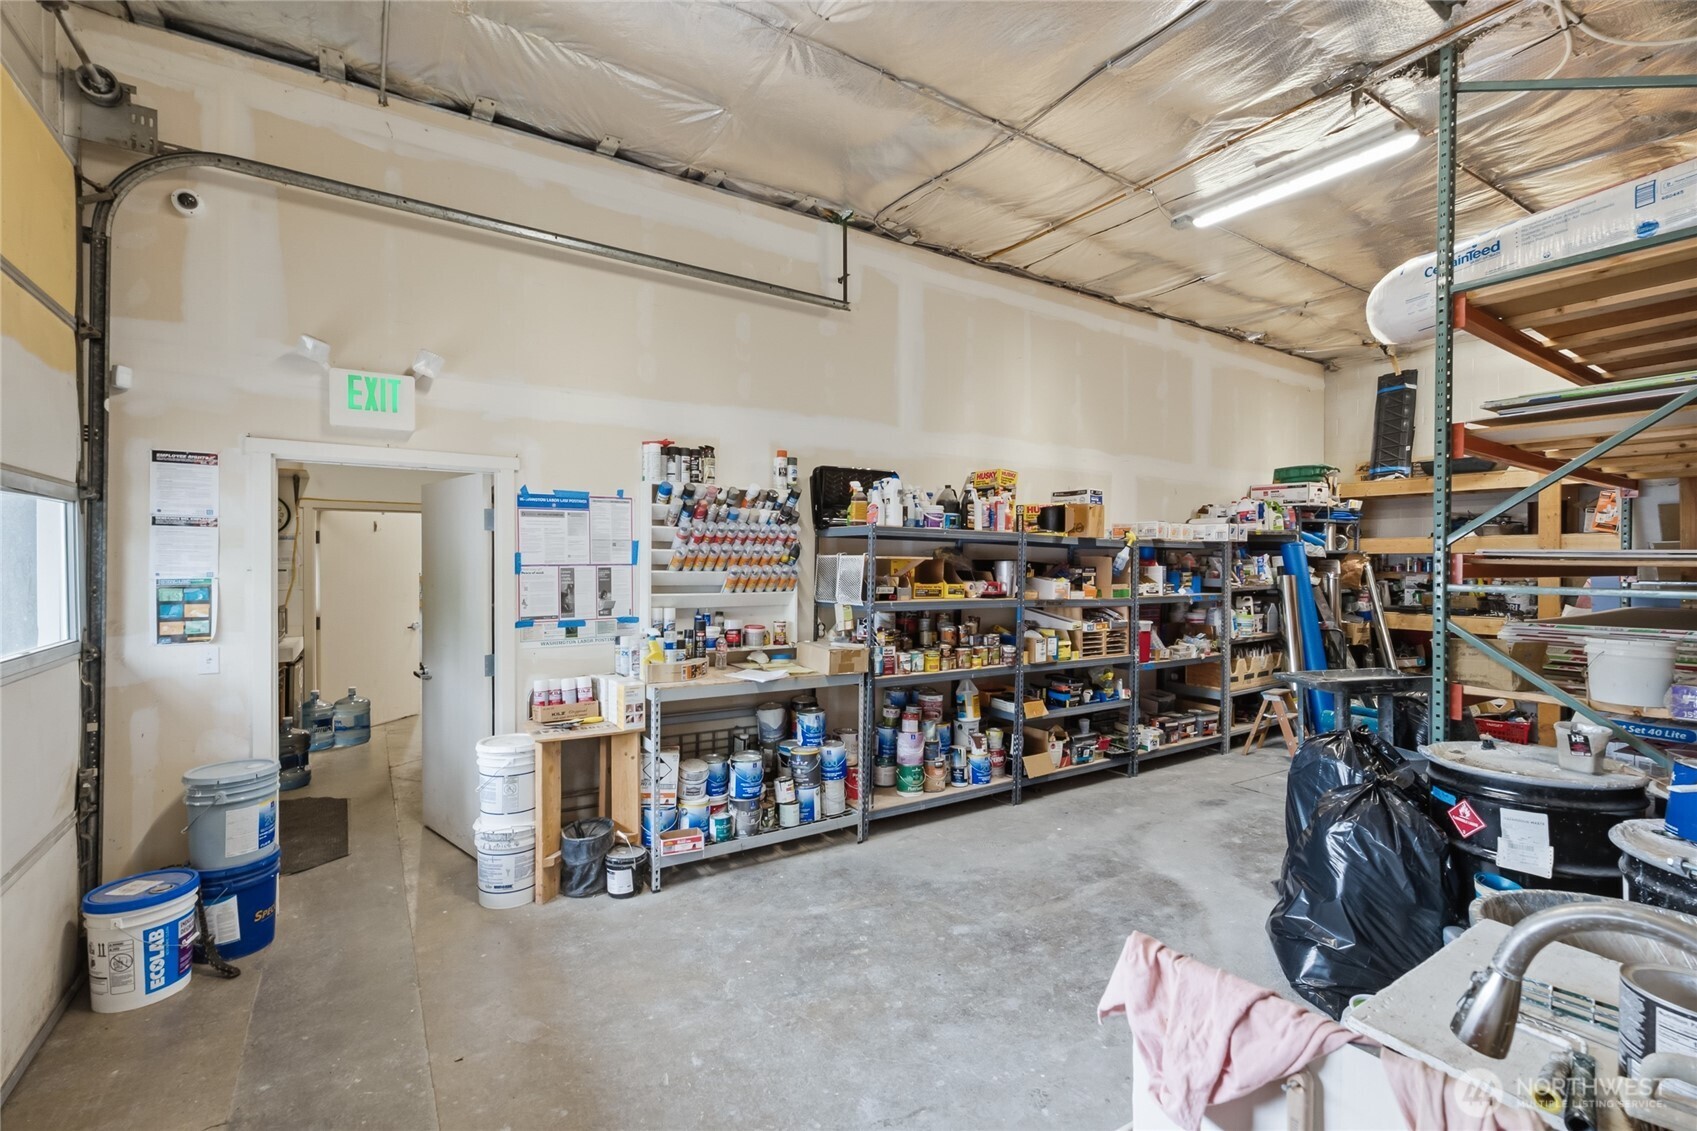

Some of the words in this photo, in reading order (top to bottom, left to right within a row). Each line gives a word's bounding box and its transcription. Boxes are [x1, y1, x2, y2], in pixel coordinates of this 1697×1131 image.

[1424, 240, 1501, 277] CeainTeed
[347, 374, 401, 413] EXIT
[976, 471, 997, 481] HUSKY
[1628, 725, 1646, 735] Set
[1647, 728, 1663, 737] 40
[1664, 730, 1687, 740] Lite
[254, 904, 275, 922] SPEC
[149, 928, 165, 991] ECOLAB
